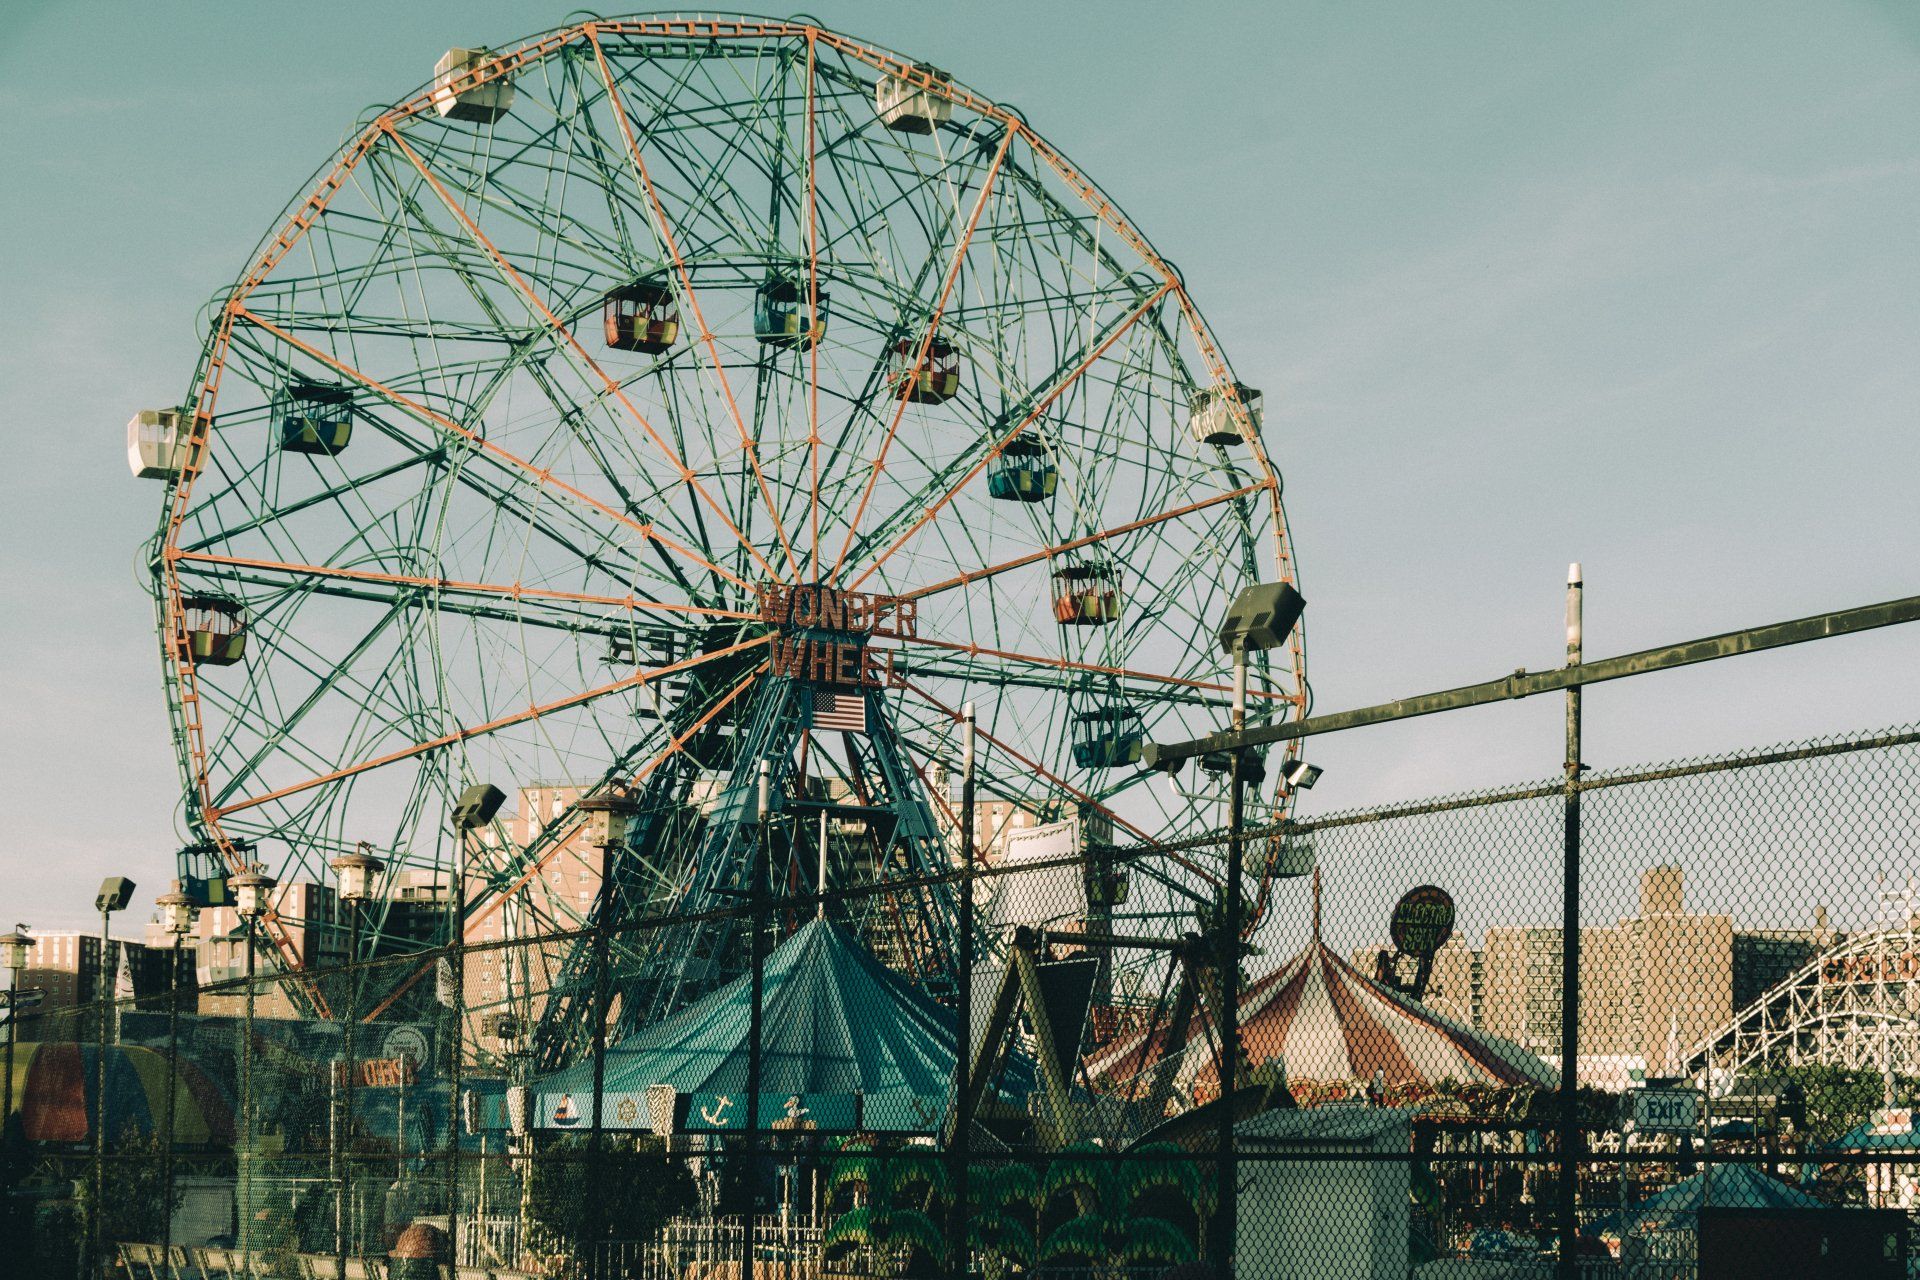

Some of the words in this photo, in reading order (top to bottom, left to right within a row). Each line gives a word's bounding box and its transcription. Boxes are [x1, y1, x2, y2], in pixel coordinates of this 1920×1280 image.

[757, 581, 917, 638] WONDER
[771, 636, 907, 690] WHEEL
[1648, 1101, 1683, 1119] EXIT
